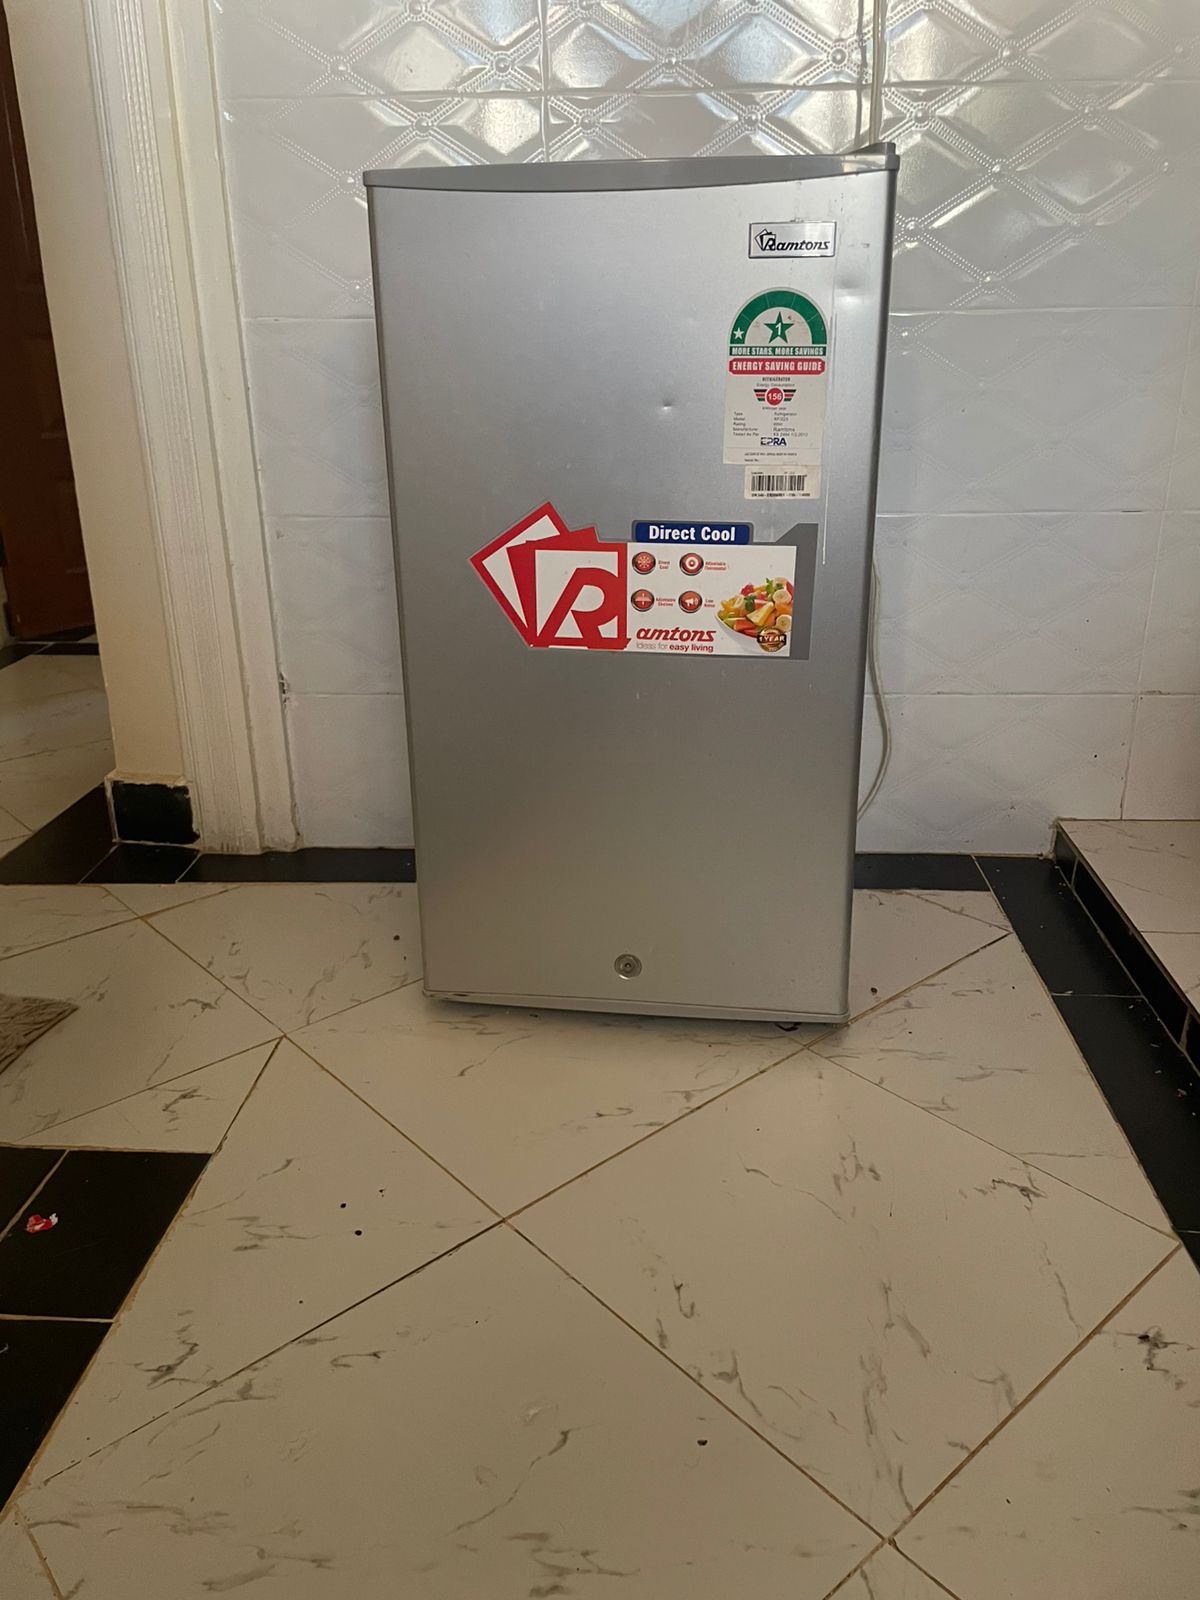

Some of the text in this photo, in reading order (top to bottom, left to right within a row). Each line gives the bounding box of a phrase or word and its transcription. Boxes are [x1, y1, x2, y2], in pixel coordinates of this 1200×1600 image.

[763, 237, 830, 251] Ramtons
[775, 322, 782, 336] 1
[731, 347, 751, 355] MORE
[774, 347, 794, 355] MORE
[795, 347, 824, 355] SAVINGS
[732, 361, 822, 371] ENERGY SAVING GUIDE
[767, 393, 782, 401] 156
[760, 437, 787, 446] EPRA
[649, 525, 736, 541] Direct Cool
[658, 642, 668, 650] for
[669, 643, 690, 652] easy
[691, 643, 714, 653] living
